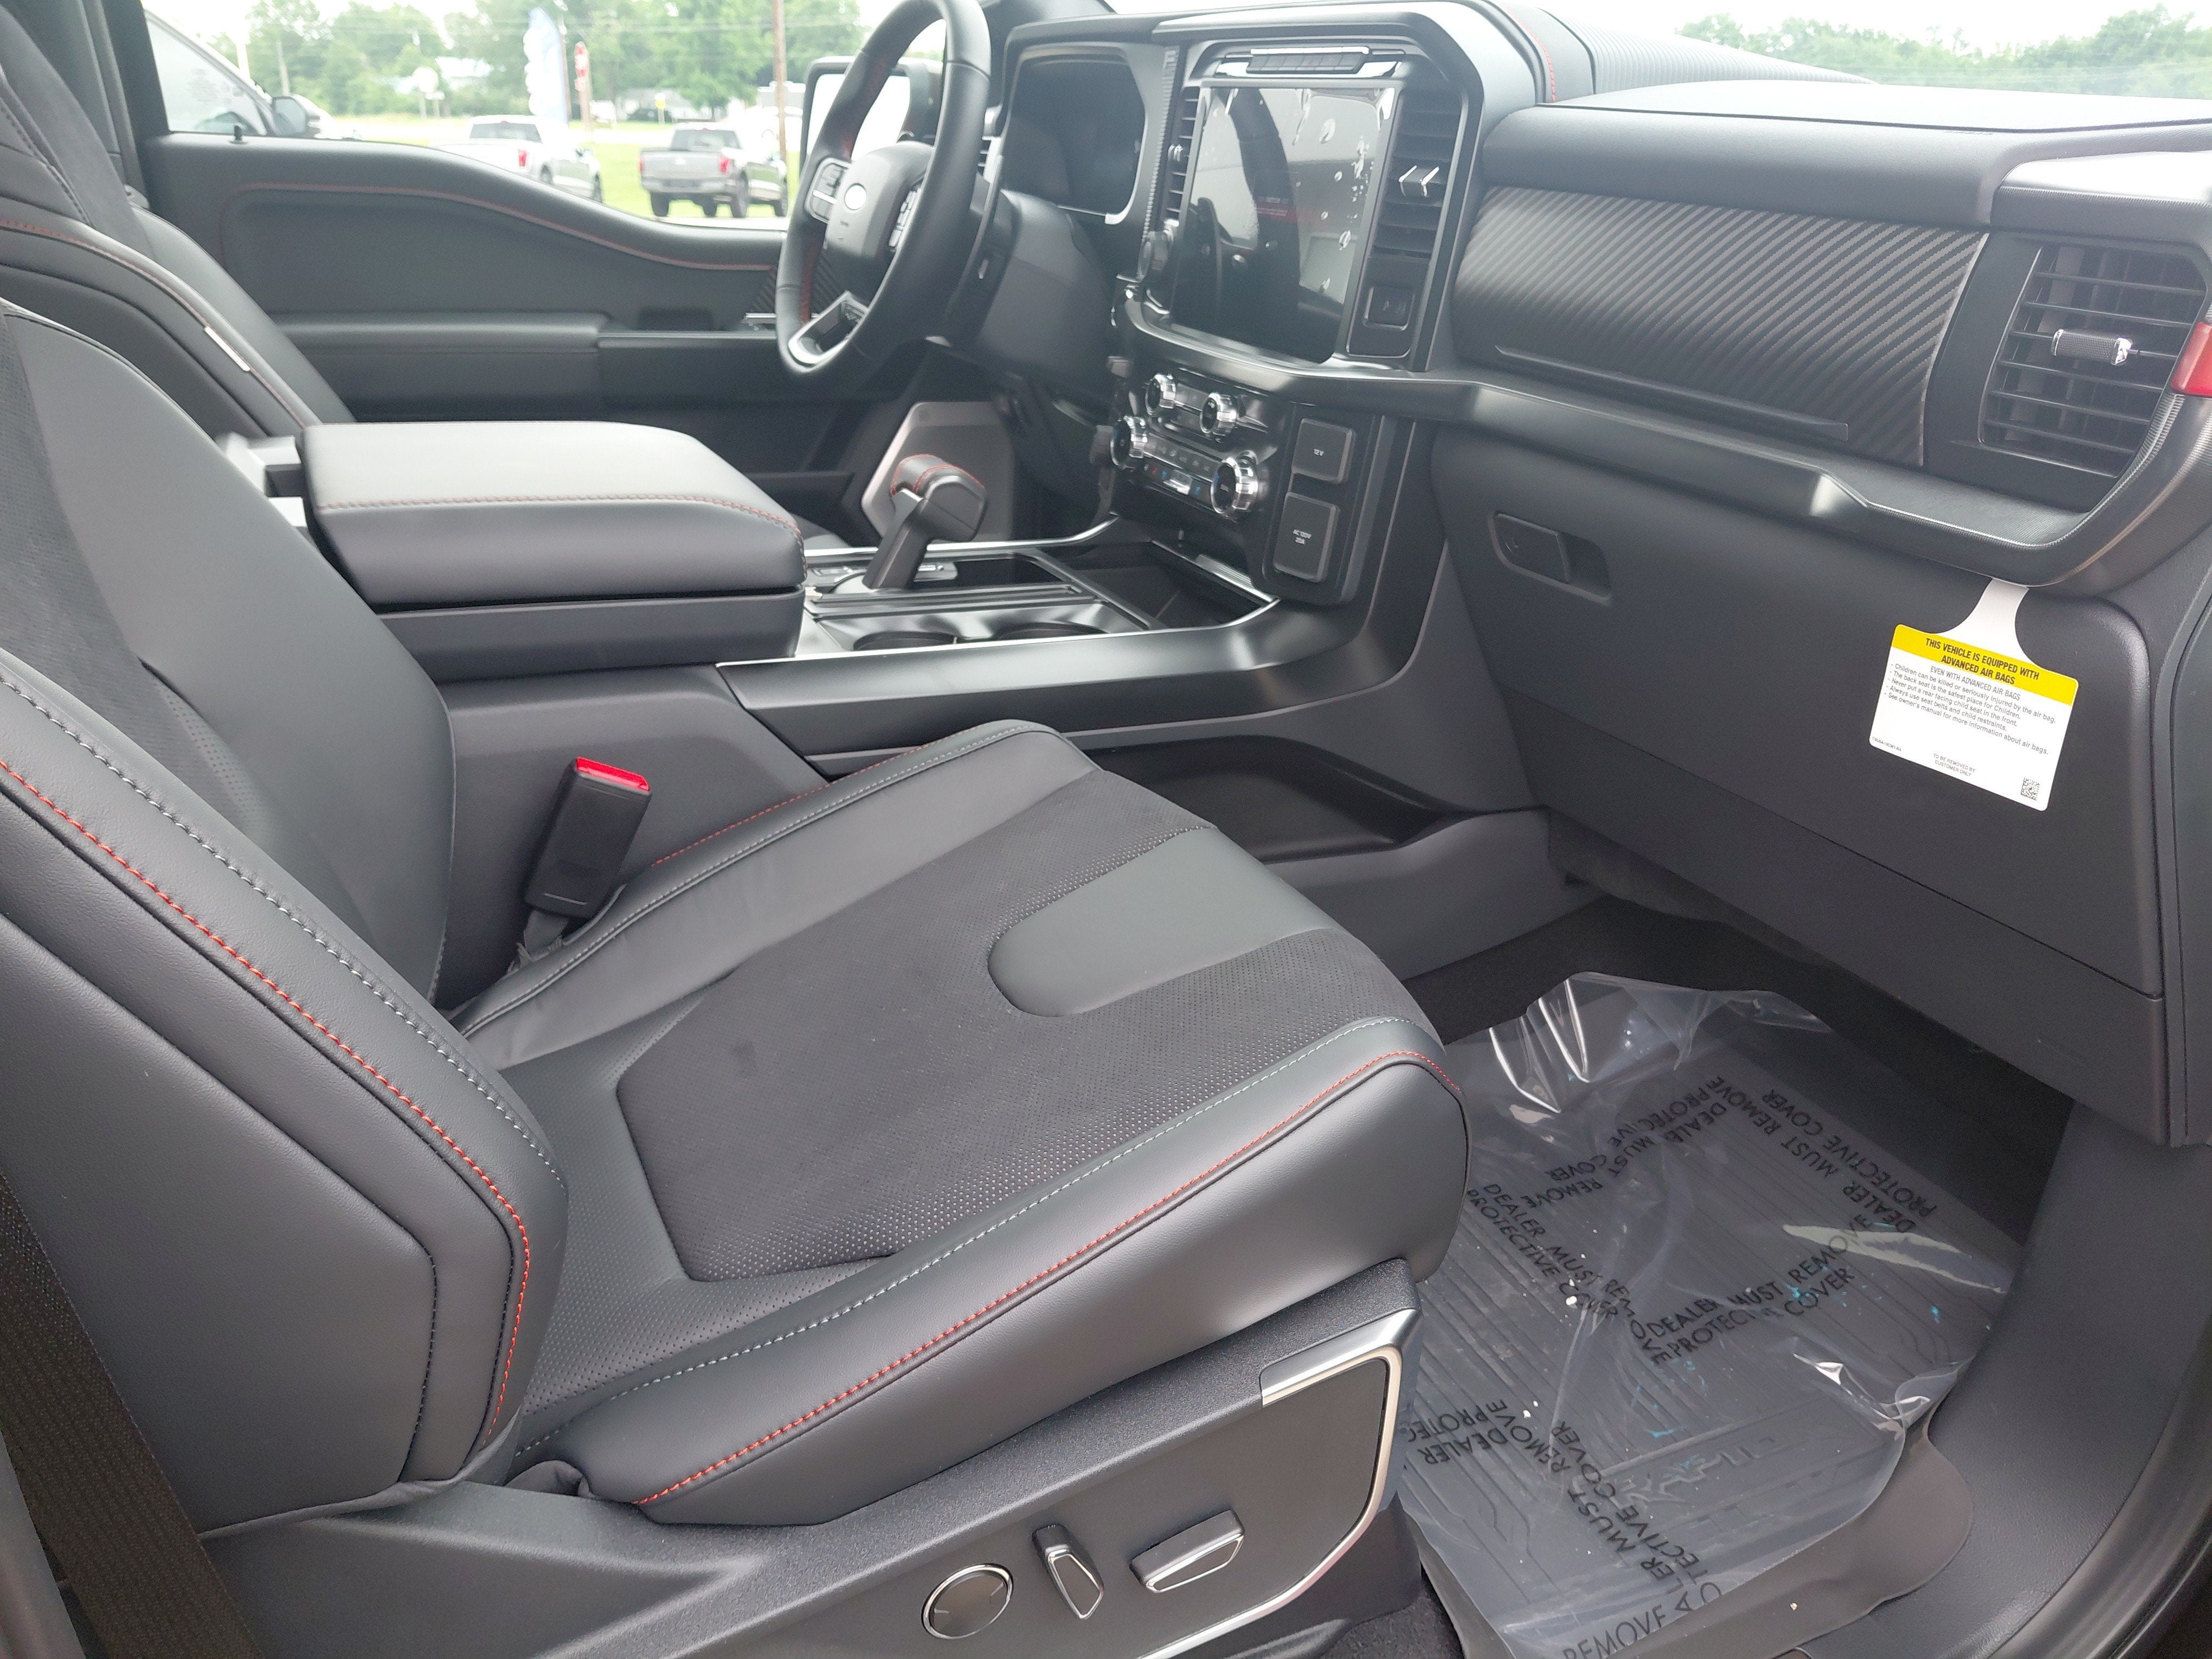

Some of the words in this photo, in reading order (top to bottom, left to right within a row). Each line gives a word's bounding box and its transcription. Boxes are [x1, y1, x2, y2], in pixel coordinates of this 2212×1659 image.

[1926, 638, 1941, 650] THIS
[1943, 642, 1972, 659] VEHICLE
[1972, 652, 1981, 662] IS
[1981, 655, 2018, 673] EQUIPPED
[2020, 666, 2040, 680] WITH
[1940, 654, 1979, 673] ADVANCED
[1979, 667, 1994, 678] AIR
[1995, 671, 2016, 685] BAGS
[1891, 677, 1907, 688] Never
[1935, 693, 1953, 705] facing
[1953, 700, 1969, 710] child
[1969, 706, 1983, 715] seat
[1990, 712, 2001, 721] the
[1894, 670, 1903, 679] The
[1904, 674, 1917, 684] back
[1918, 680, 1930, 689] seat
[1937, 686, 1947, 694] the
[1947, 690, 1966, 700] safest
[1966, 697, 1983, 706] place
[1994, 705, 2021, 719] Children.
[1895, 663, 1917, 676] Children
[1938, 678, 1954, 688] killed
[1962, 687, 1990, 701] seriously
[1990, 695, 2012, 708] injured
[2013, 703, 2022, 712] by
[2022, 706, 2032, 715] the
[2042, 713, 2055, 724] bag.
[1930, 666, 1945, 676] EVEN
[1946, 671, 1960, 681] WITH
[1961, 676, 1992, 691] ADVANCED
[1992, 686, 2004, 695] AIR
[2004, 690, 2021, 701] BAGS
[1888, 692, 1898, 700] See
[1898, 697, 1920, 709] owner's
[1921, 705, 1942, 716] manual
[1952, 716, 1967, 725] more
[1969, 721, 2003, 738] information
[2003, 735, 2022, 745] about
[2031, 743, 2048, 755] bags.
[1889, 685, 1908, 697] Always
[1920, 697, 1933, 705] seat
[1934, 700, 1948, 710] belts
[1961, 711, 1977, 721] child
[1977, 717, 2007, 731] restraints.
[1934, 760, 1959, 771] CUSTOMER
[1947, 758, 1969, 770] REMOVED
[1706, 1076, 1781, 1135] REMOVE
[1763, 1090, 1823, 1138] COVER
[1609, 1136, 1655, 1177] MUST
[1781, 1136, 1838, 1177] MUST
[1823, 1135, 1937, 1217] PROTECTIVE
[1521, 1179, 1603, 1208] REMOVE
[1843, 1180, 1916, 1232] DEALER
[1467, 1188, 1560, 1278] PROTECTIVE
[1483, 1184, 1546, 1238] DEALER
[1546, 1246, 1601, 1287] MUST
[1788, 1214, 1870, 1283] REMOVE
[1784, 1268, 1855, 1316] COVER
[1417, 1431, 1508, 1465] DEALER
[1486, 1399, 1571, 1473] REMOVE
[1551, 1420, 1617, 1500] COVER
[1567, 1489, 1636, 1552] MUST
